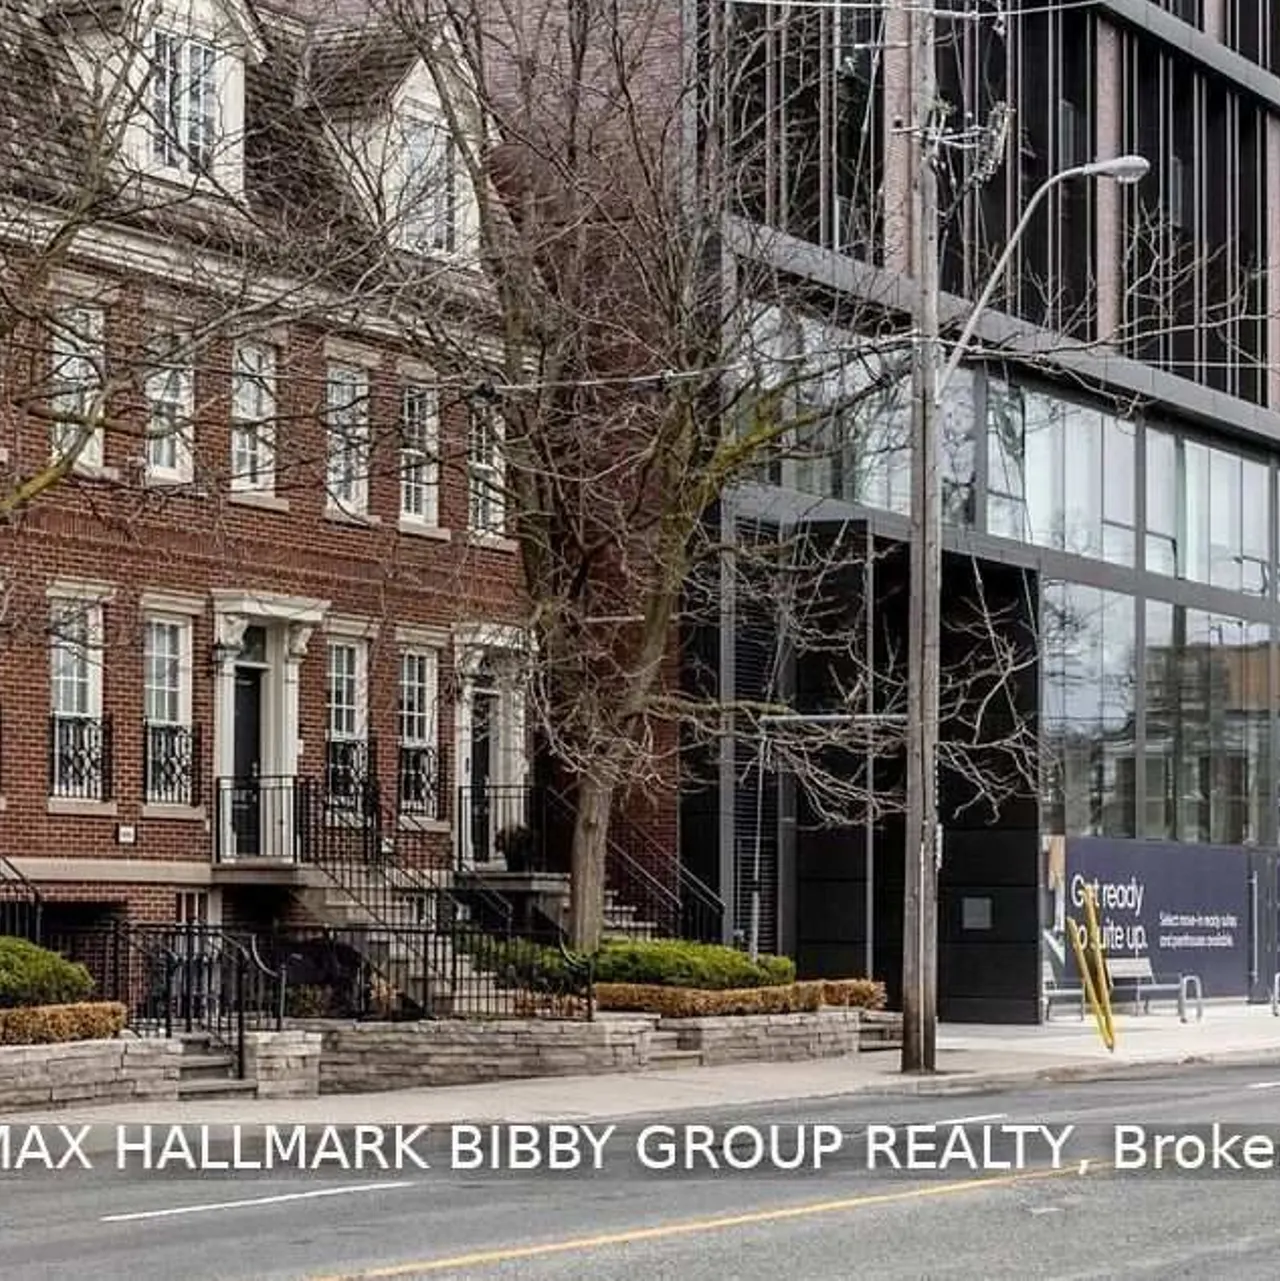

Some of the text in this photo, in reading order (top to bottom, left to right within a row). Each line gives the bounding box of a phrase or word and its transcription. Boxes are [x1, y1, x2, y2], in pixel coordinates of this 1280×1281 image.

[1071, 874, 1144, 916] Gt ready
[1089, 917, 1124, 951] uite
[1126, 925, 1149, 957] up.
